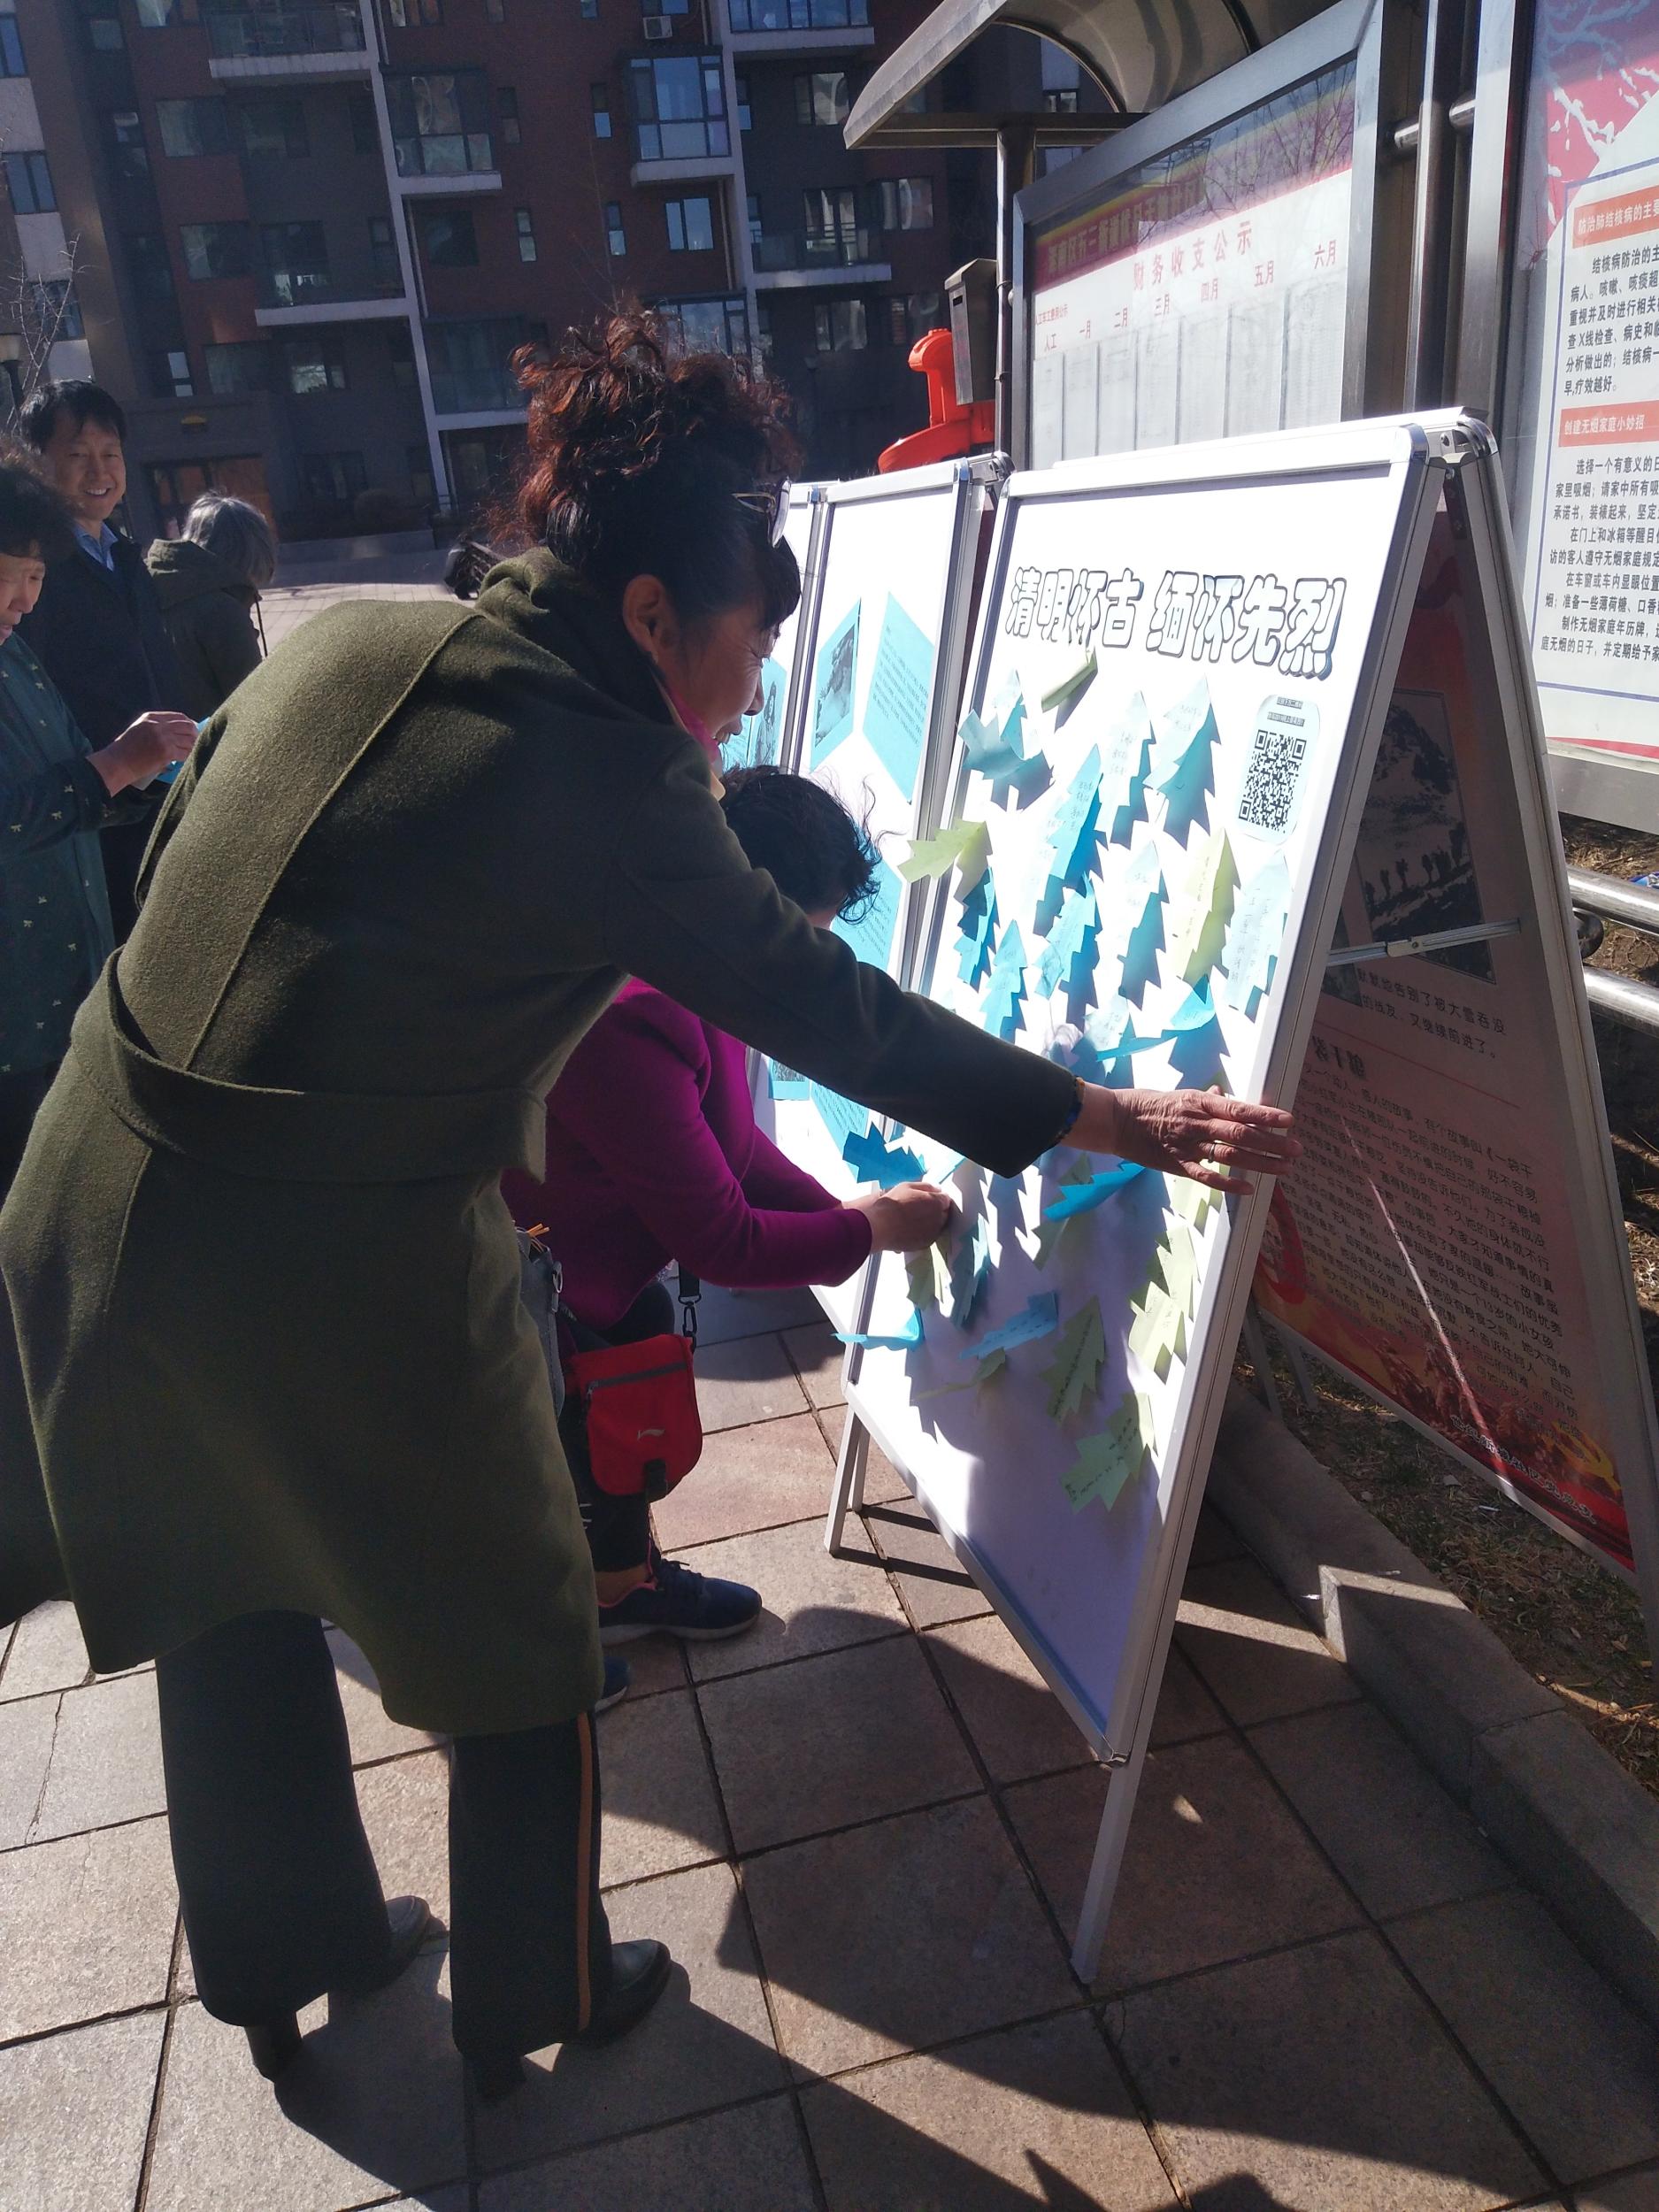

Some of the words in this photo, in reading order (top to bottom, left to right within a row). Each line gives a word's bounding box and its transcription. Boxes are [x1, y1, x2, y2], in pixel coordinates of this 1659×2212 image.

[1133, 221, 1252, 290] 财务收支公示
[1114, 307, 1128, 328] 二月
[1154, 294, 1171, 318] 三月
[1201, 278, 1218, 302] 四月
[1254, 260, 1274, 287] 五月
[1314, 240, 1337, 269] 六月
[1569, 296, 1659, 326] 重视并及时进行相关
[1564, 414, 1645, 435] 创建无烟家庭小妙招
[1554, 503, 1659, 520] 承诺书，装裱起来，坚定
[1545, 592, 1659, 615] 烟；准备一些薄荷糖、口香
[1006, 566, 1145, 649] 清明怀古
[1146, 570, 1347, 681] 缅怀先烈
